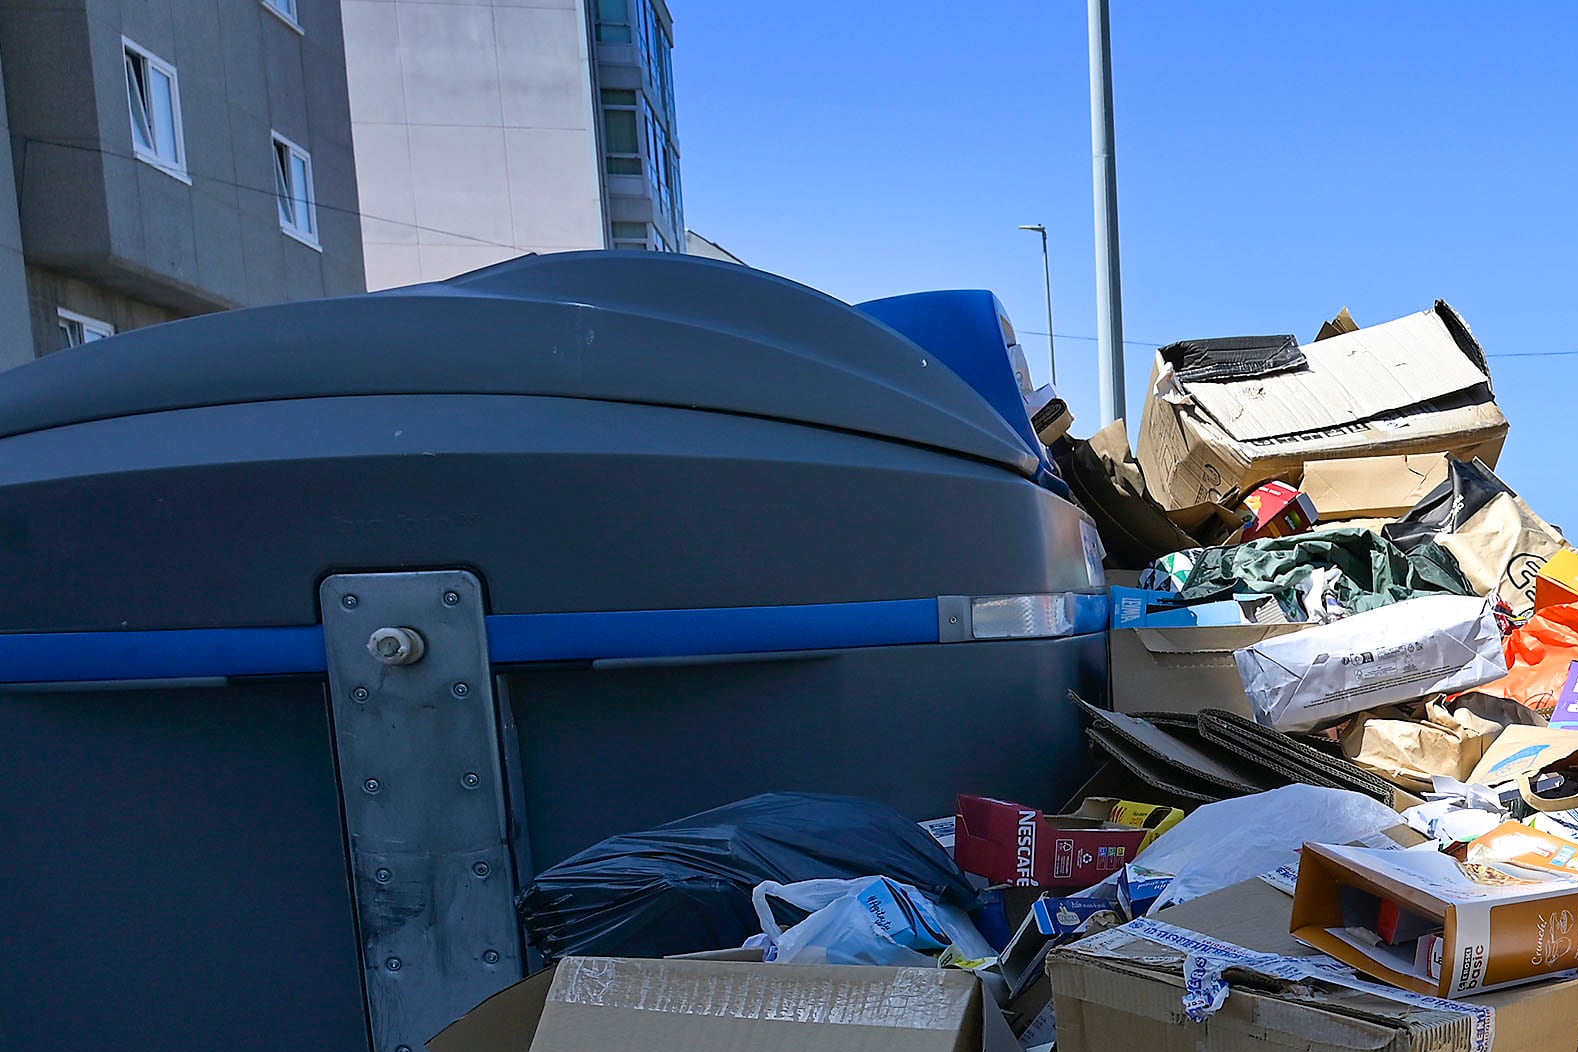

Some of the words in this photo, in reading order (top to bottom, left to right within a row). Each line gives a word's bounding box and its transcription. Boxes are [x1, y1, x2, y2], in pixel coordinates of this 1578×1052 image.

[1017, 810, 1040, 888] NESCAFÉ
[1461, 947, 1473, 981] EROSKI
[1531, 914, 1550, 966] Crunch!
[1466, 944, 1485, 990] basic
